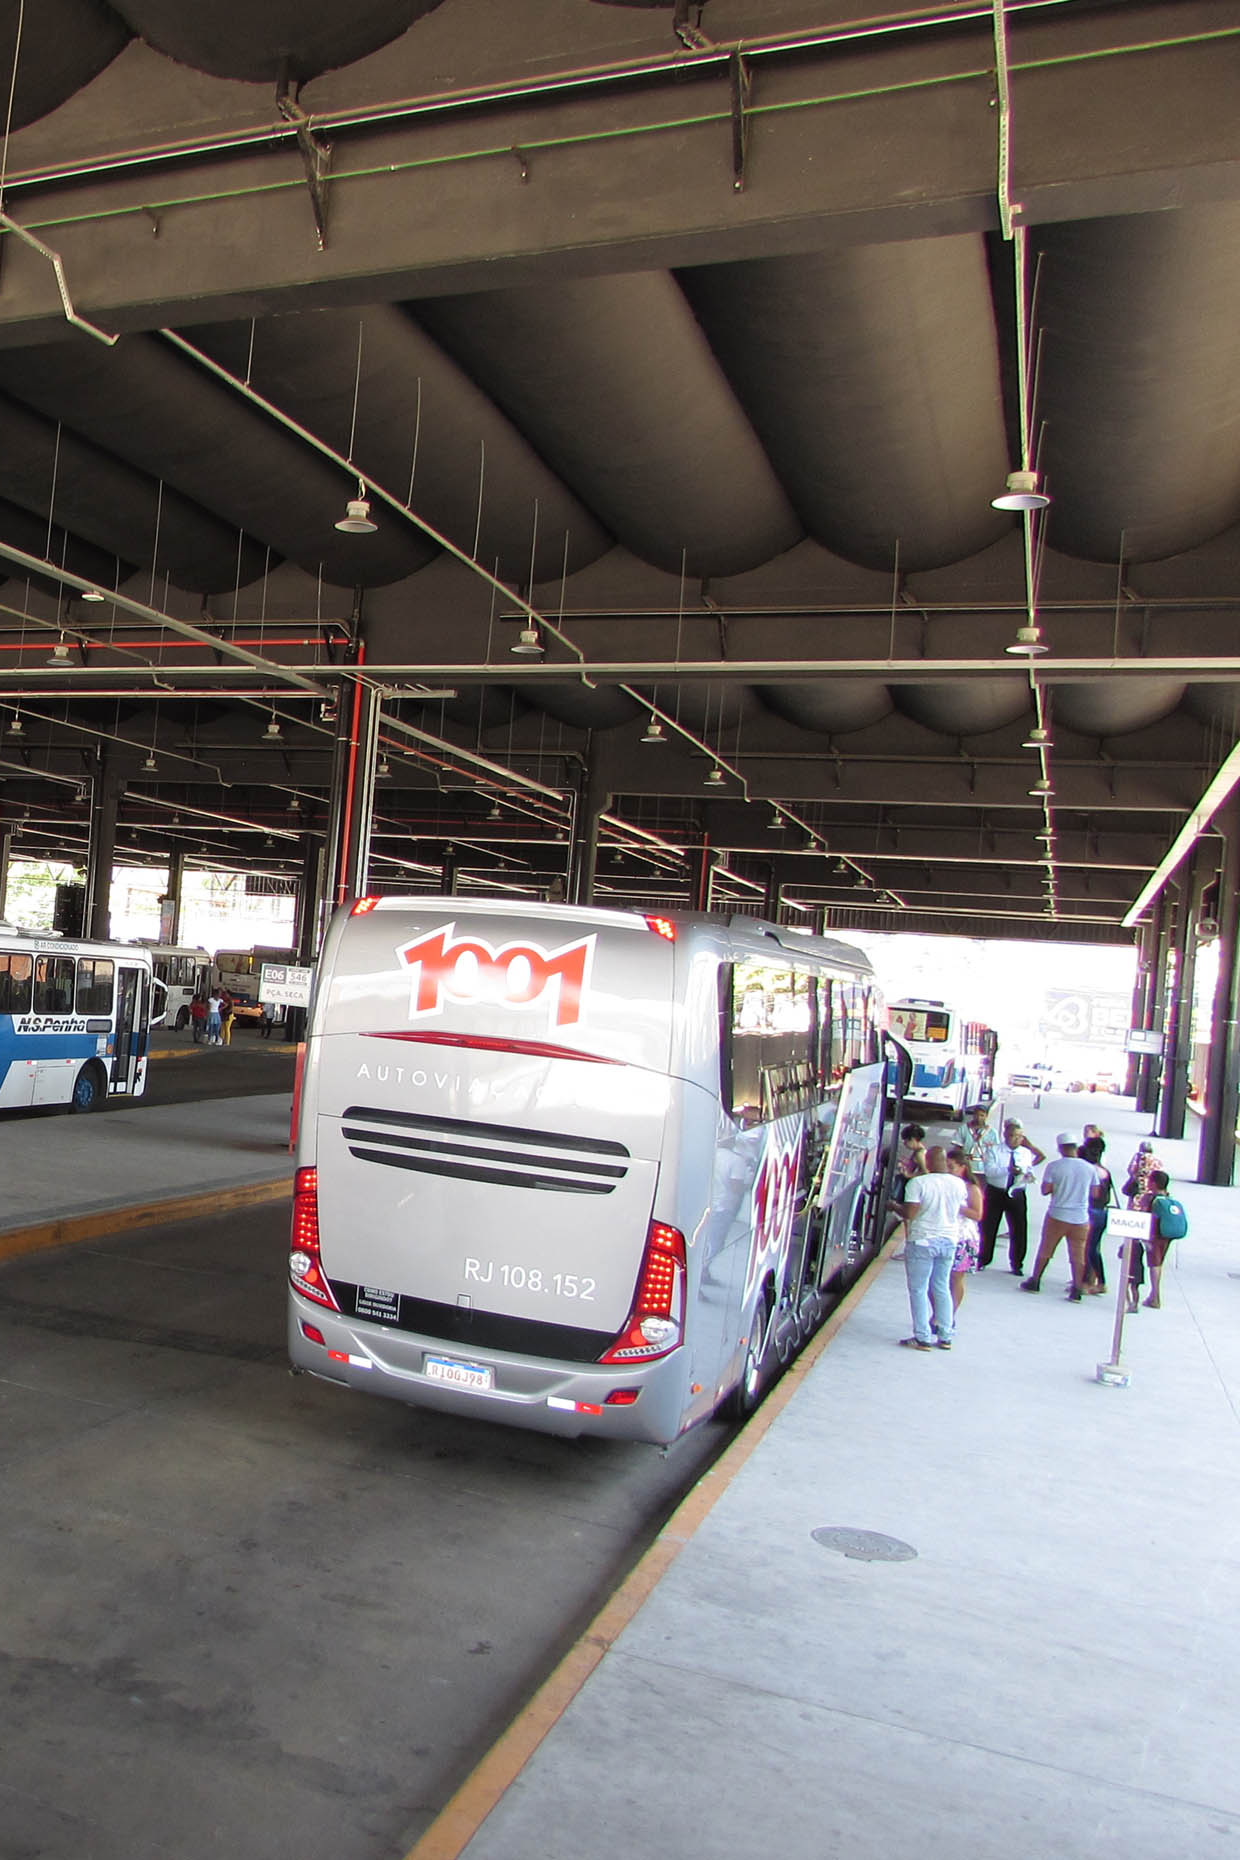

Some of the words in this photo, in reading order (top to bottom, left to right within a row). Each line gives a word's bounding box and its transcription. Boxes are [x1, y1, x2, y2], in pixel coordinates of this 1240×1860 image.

[265, 968, 285, 980] E06
[290, 973, 307, 982] 546
[398, 925, 594, 1028] 1001
[464, 1257, 493, 1282] RJ
[500, 1264, 596, 1301] 108.152
